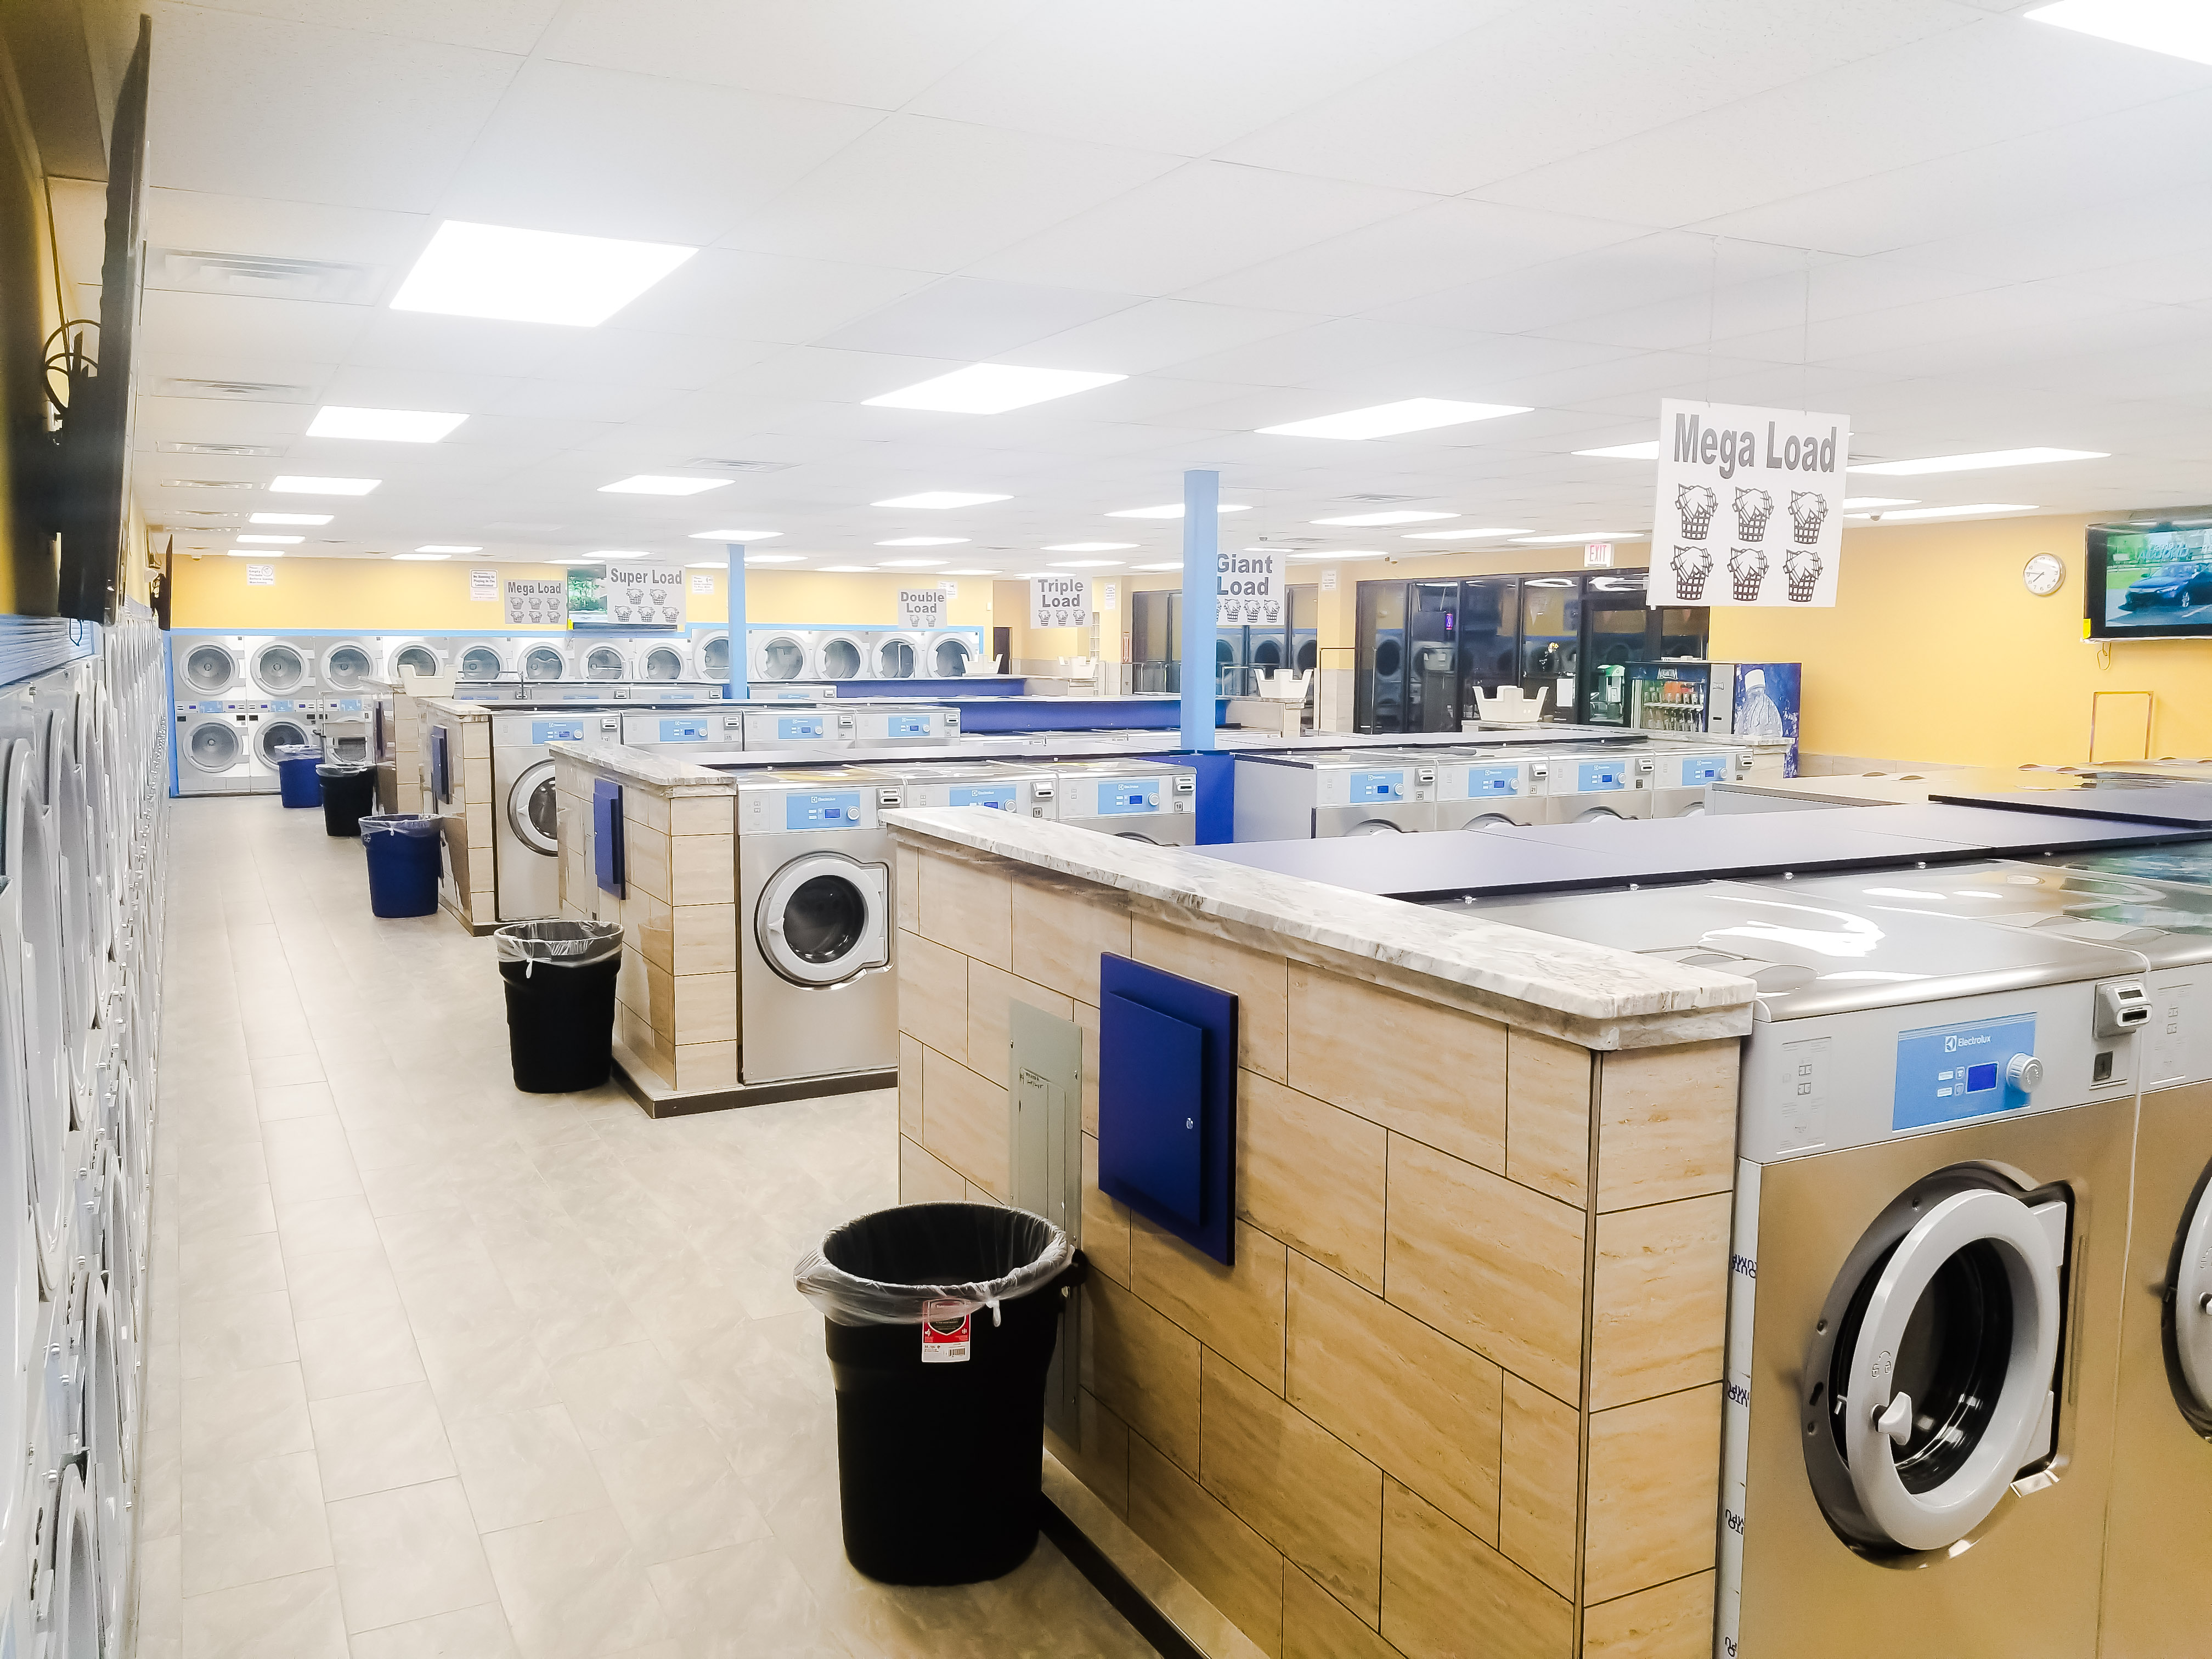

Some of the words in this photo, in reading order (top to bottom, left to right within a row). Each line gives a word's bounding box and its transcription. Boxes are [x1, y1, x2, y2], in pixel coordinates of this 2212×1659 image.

[1674, 413, 1755, 479] Mega
[1767, 421, 1837, 472] Load
[1590, 545, 1606, 562] EXIT
[1217, 554, 1273, 573] Giant
[611, 568, 648, 586] Super
[652, 569, 682, 584] Load
[508, 582, 534, 595] Mega
[538, 582, 561, 594] Load
[1038, 579, 1084, 595] Triple
[1217, 577, 1268, 595] Load
[901, 591, 945, 602] Double
[1042, 594, 1080, 607] Load
[906, 603, 936, 613] Load
[1958, 1035, 1991, 1047] Electrolux
